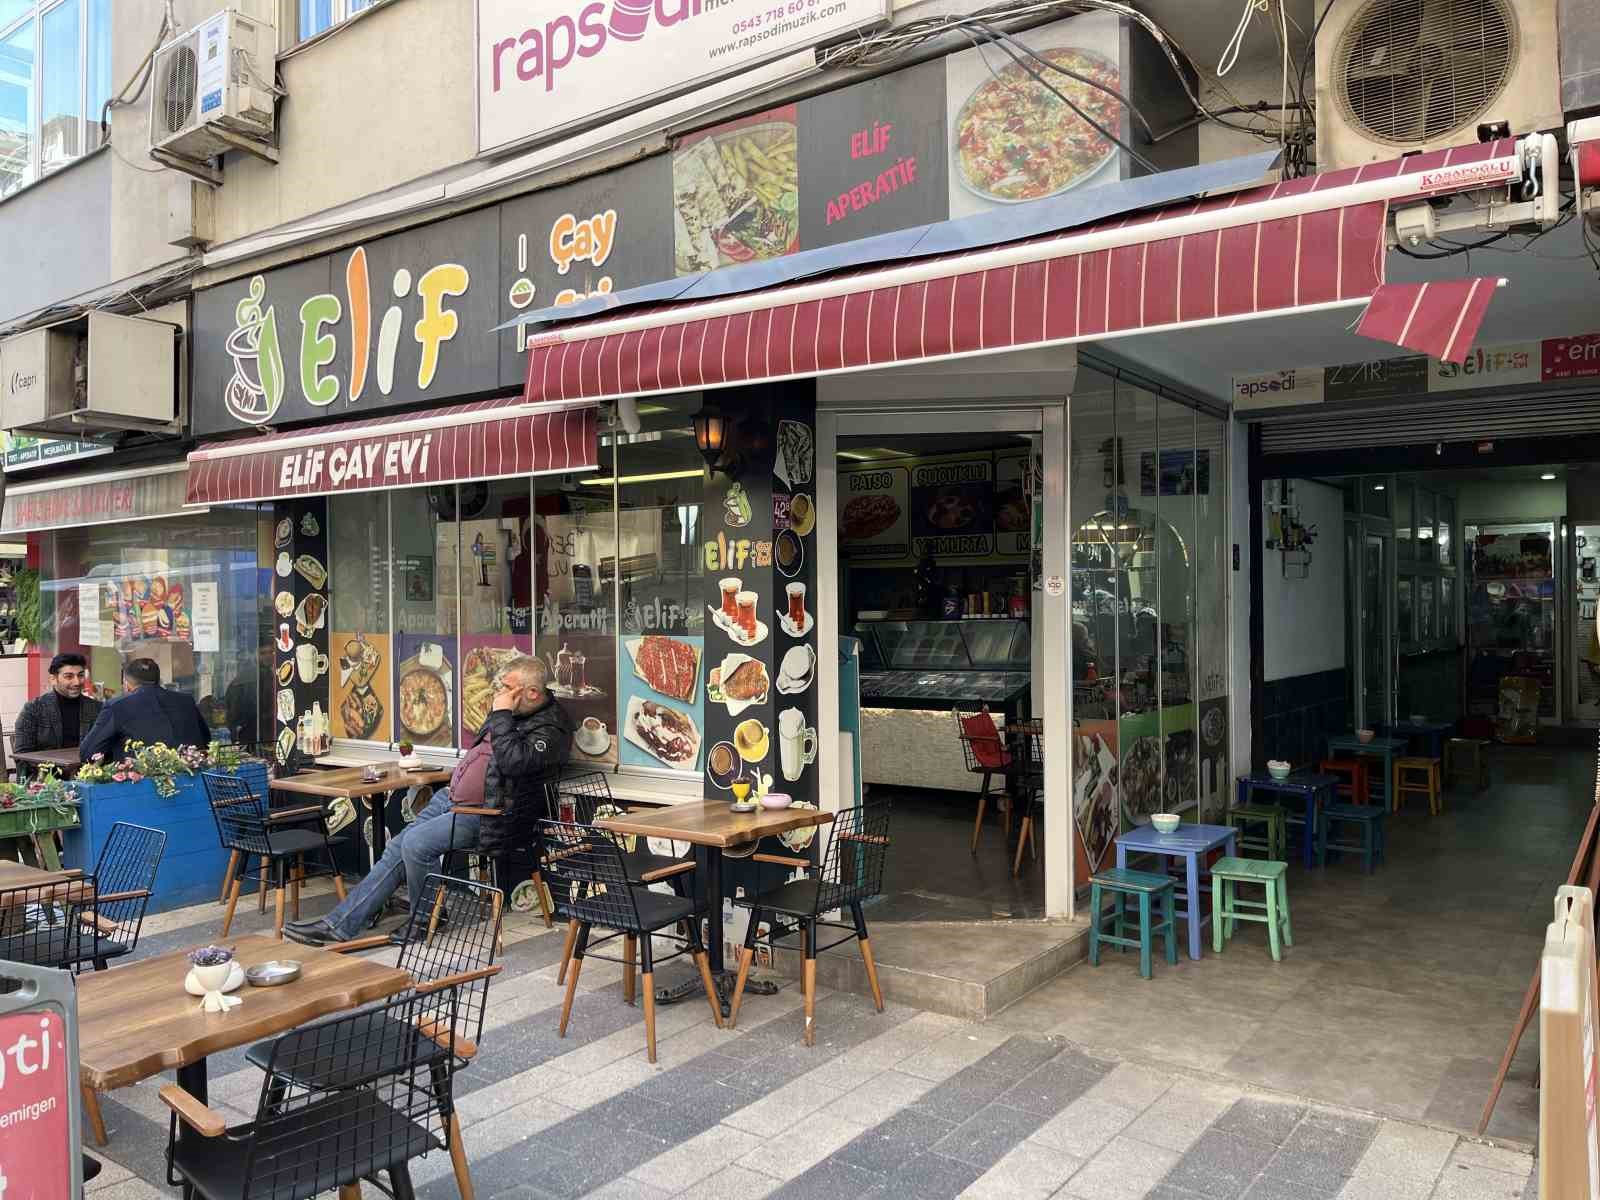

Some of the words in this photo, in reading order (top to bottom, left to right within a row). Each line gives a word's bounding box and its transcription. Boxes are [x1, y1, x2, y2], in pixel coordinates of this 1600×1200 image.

[708, 1, 847, 59] www.rapsodimuzik.com
[732, 14, 762, 35] 0543
[766, 7, 784, 24] 718
[850, 120, 893, 160] ELİF
[825, 156, 917, 226] APERATİF
[550, 209, 617, 275] Çay
[279, 448, 325, 489] ELİF
[329, 442, 382, 487] ÇAY
[384, 434, 432, 477] EVİ
